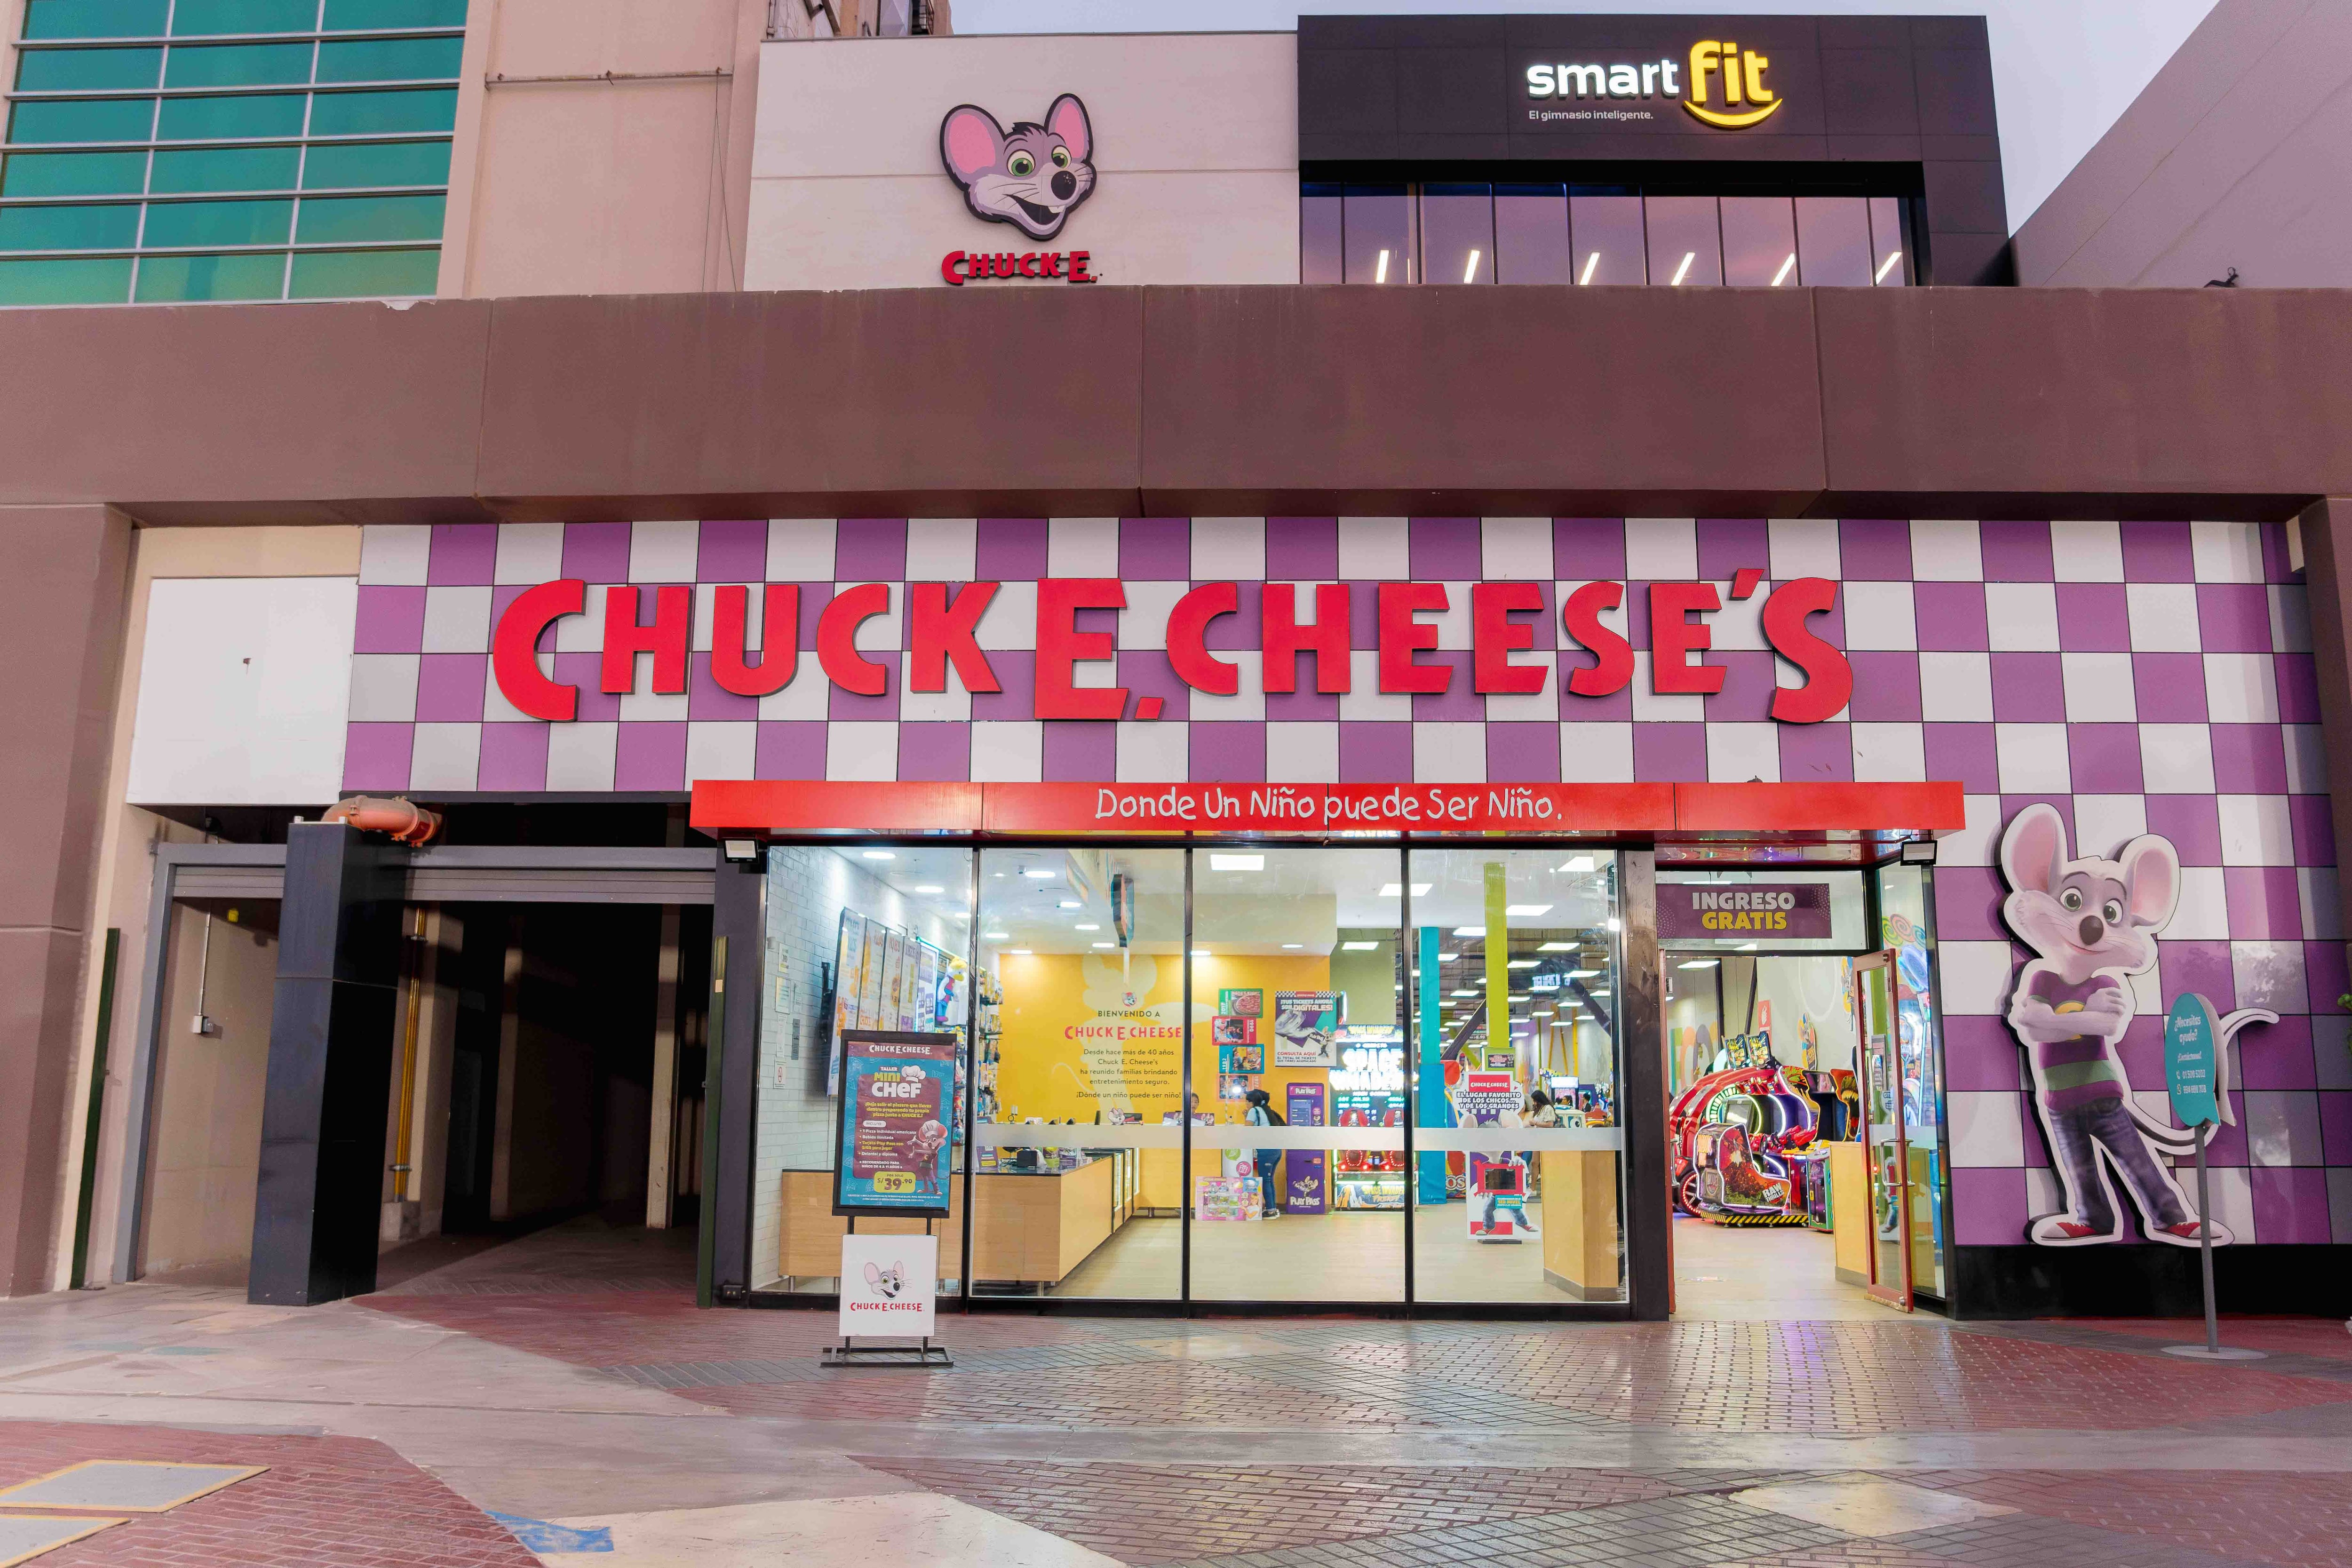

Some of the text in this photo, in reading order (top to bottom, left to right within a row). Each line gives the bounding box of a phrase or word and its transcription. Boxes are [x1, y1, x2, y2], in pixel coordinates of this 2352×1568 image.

[1526, 40, 1773, 103] smart fit
[1529, 110, 1653, 121] El gimnasio inteligente.
[942, 251, 1061, 285] CHUCK
[492, 569, 1854, 724] CHUCK E. CHEESE'S
[1095, 786, 1562, 825] Donde Un Niño puede Ser Niño.
[1692, 892, 1796, 910] INGRESO
[1702, 912, 1788, 930] GRATIS
[1065, 1026, 1113, 1040] CHUCK
[1130, 1027, 1182, 1038] CHEESE
[902, 1046, 931, 1055] CHEESE
[1762, 1182, 1782, 1198] RAW
[1290, 1196, 1321, 1206] PLAY PASS
[850, 1302, 880, 1311] CHUCK
[890, 1303, 922, 1312] CHEESE
